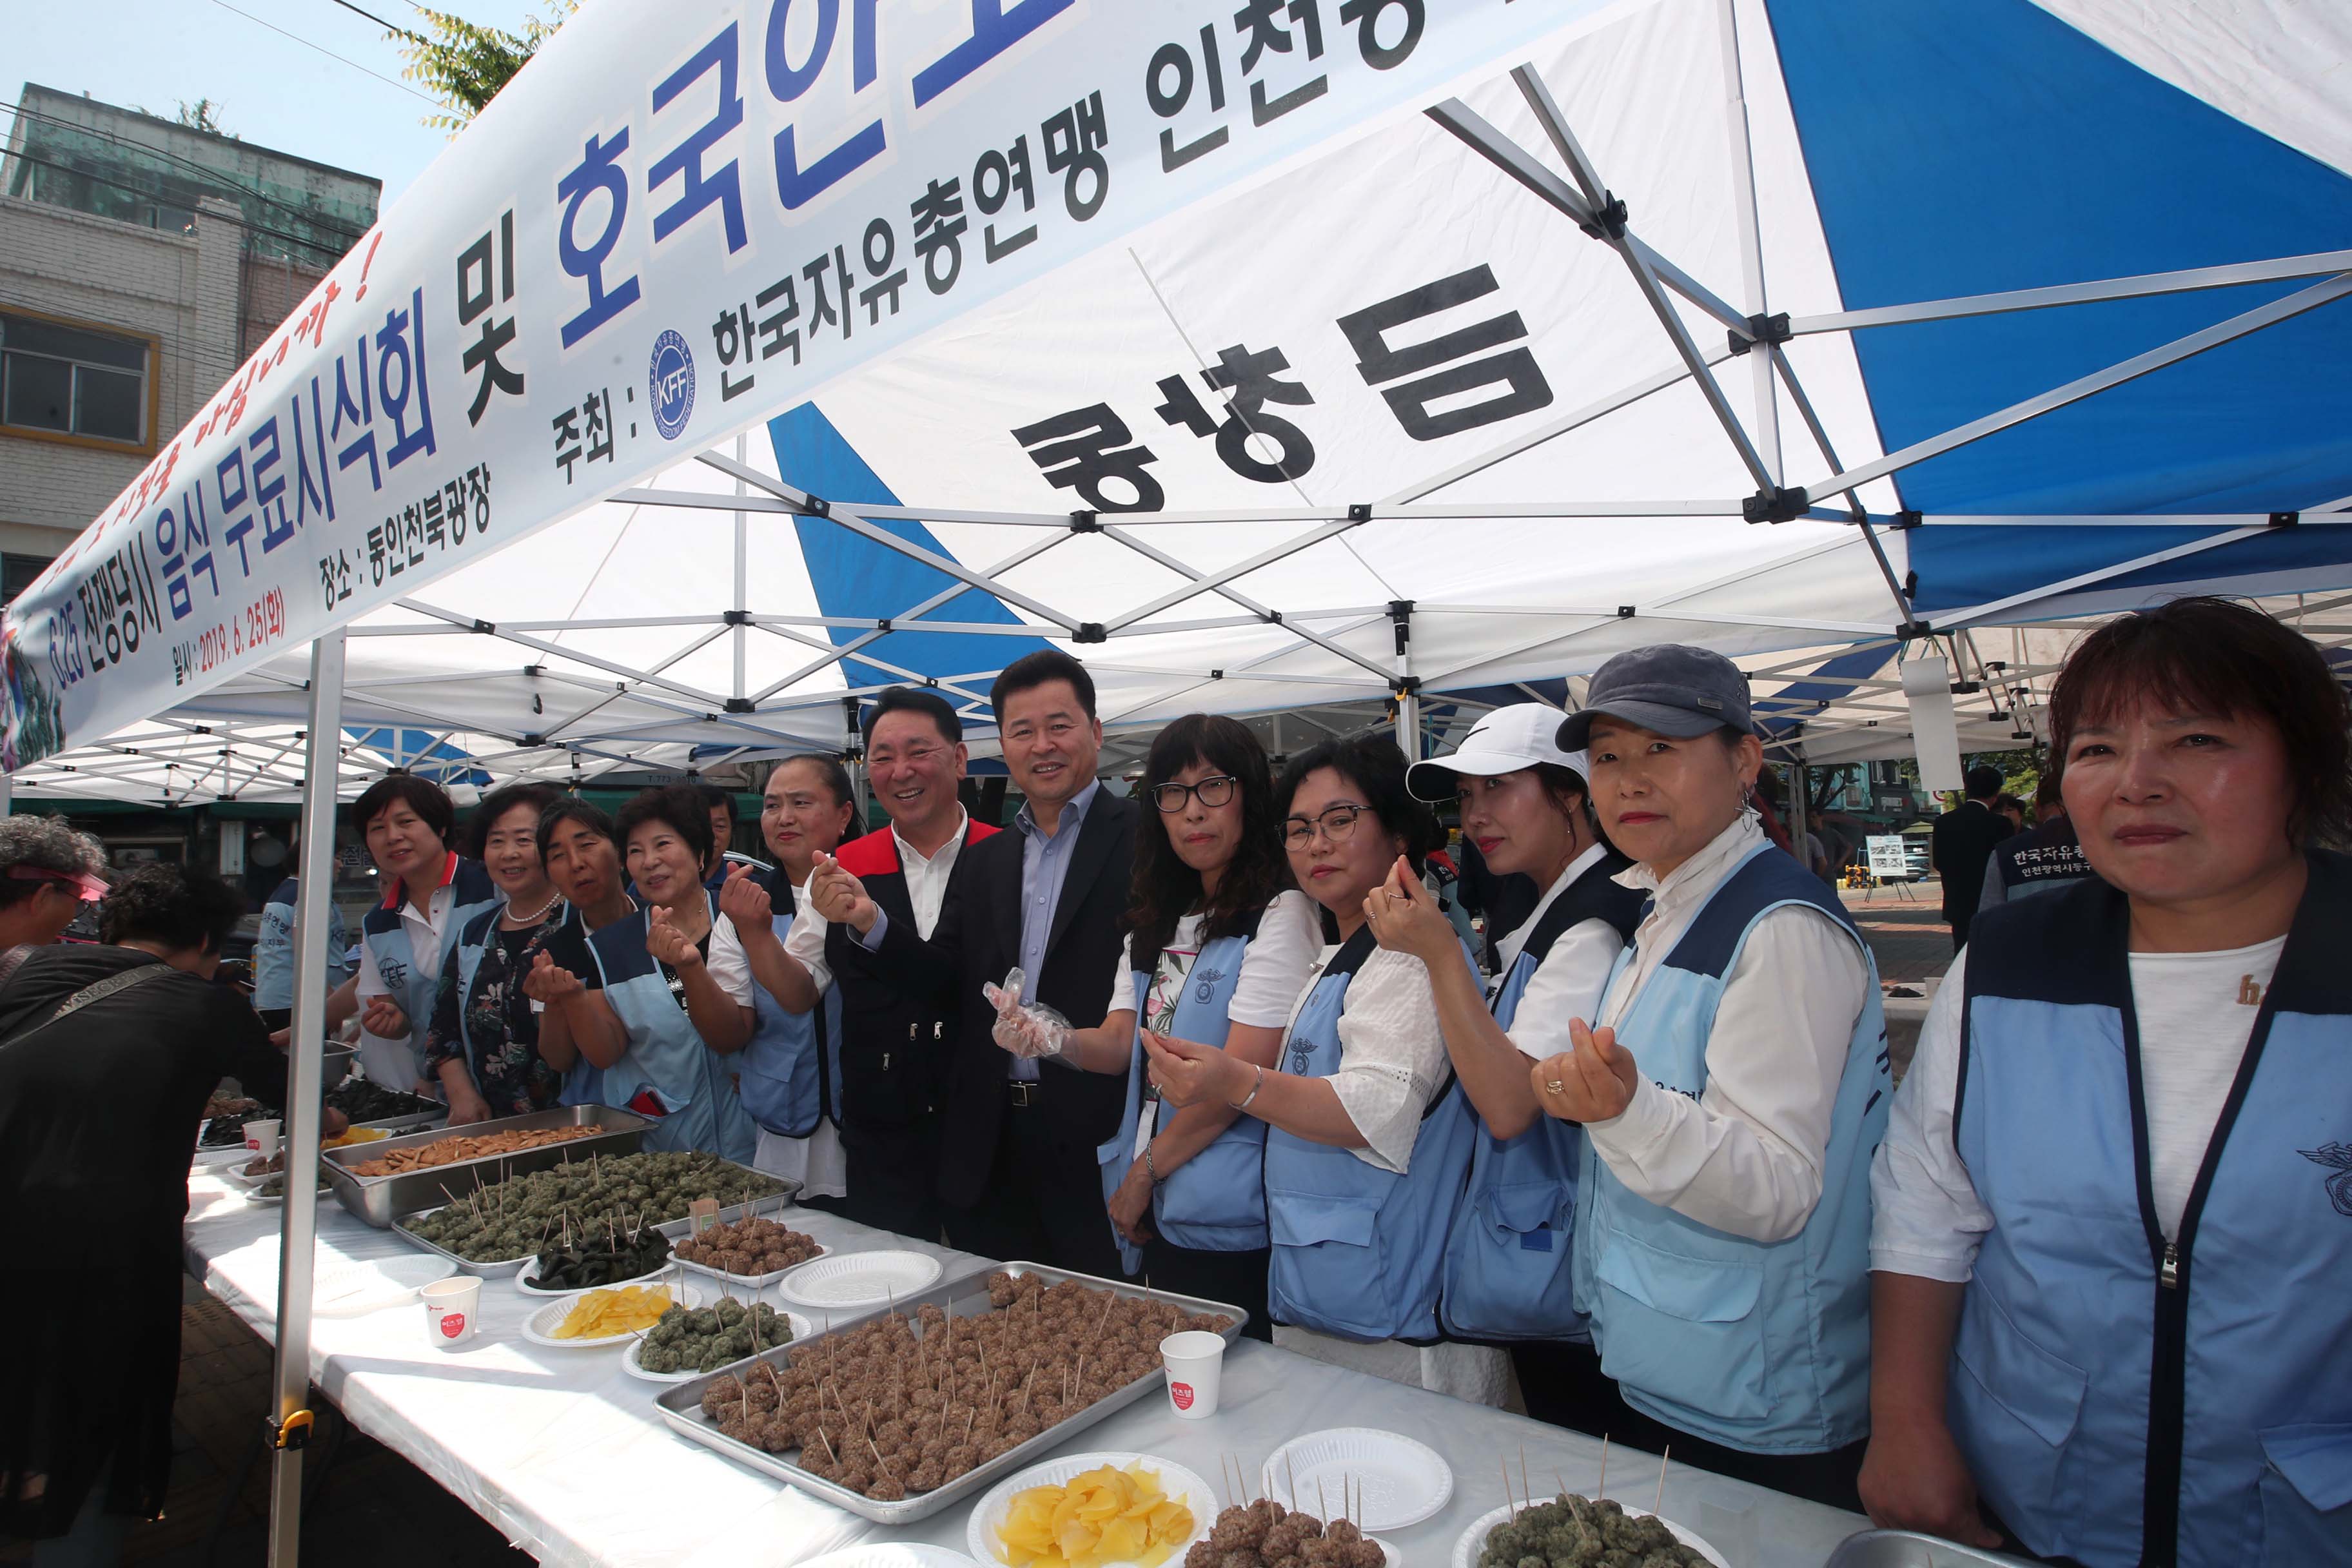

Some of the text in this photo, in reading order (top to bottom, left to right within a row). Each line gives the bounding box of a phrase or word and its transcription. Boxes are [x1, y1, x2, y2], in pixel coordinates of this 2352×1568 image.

[553, 387, 614, 484] 주최
[712, 90, 1109, 402] 한국자유총연맹
[77, 530, 162, 672] 전쟁당시
[155, 480, 220, 621] 음식
[217, 286, 437, 578] 무료시식회
[456, 208, 524, 429] 및
[650, 362, 694, 438] KOREA FREEDOM FEDERATION
[657, 366, 687, 409] KFF
[318, 547, 353, 611] 장소
[366, 462, 491, 587] 동인천북광장
[173, 641, 193, 686] 일시
[248, 584, 286, 649] 25(화)
